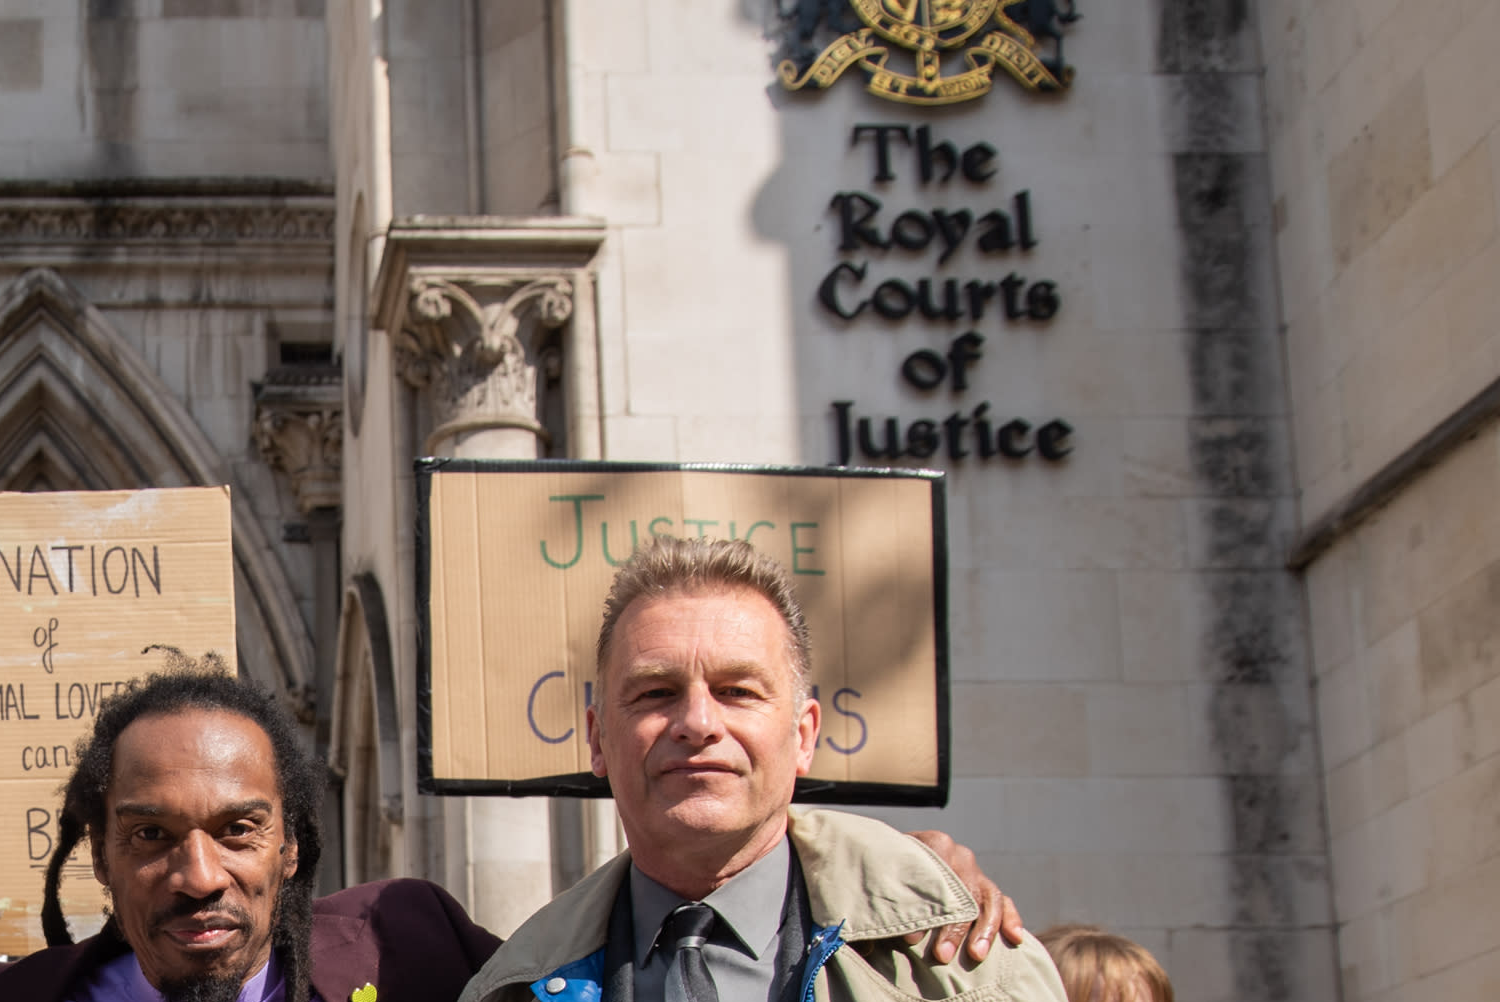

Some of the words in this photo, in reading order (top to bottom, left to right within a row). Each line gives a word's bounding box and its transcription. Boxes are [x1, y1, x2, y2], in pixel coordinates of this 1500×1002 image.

[850, 123, 999, 185] The
[829, 189, 1037, 264] Royal
[818, 261, 1061, 321] Courts
[901, 331, 985, 391] of
[830, 400, 1075, 466] Justice
[33, 617, 60, 674] of
[21, 743, 71, 771] can
